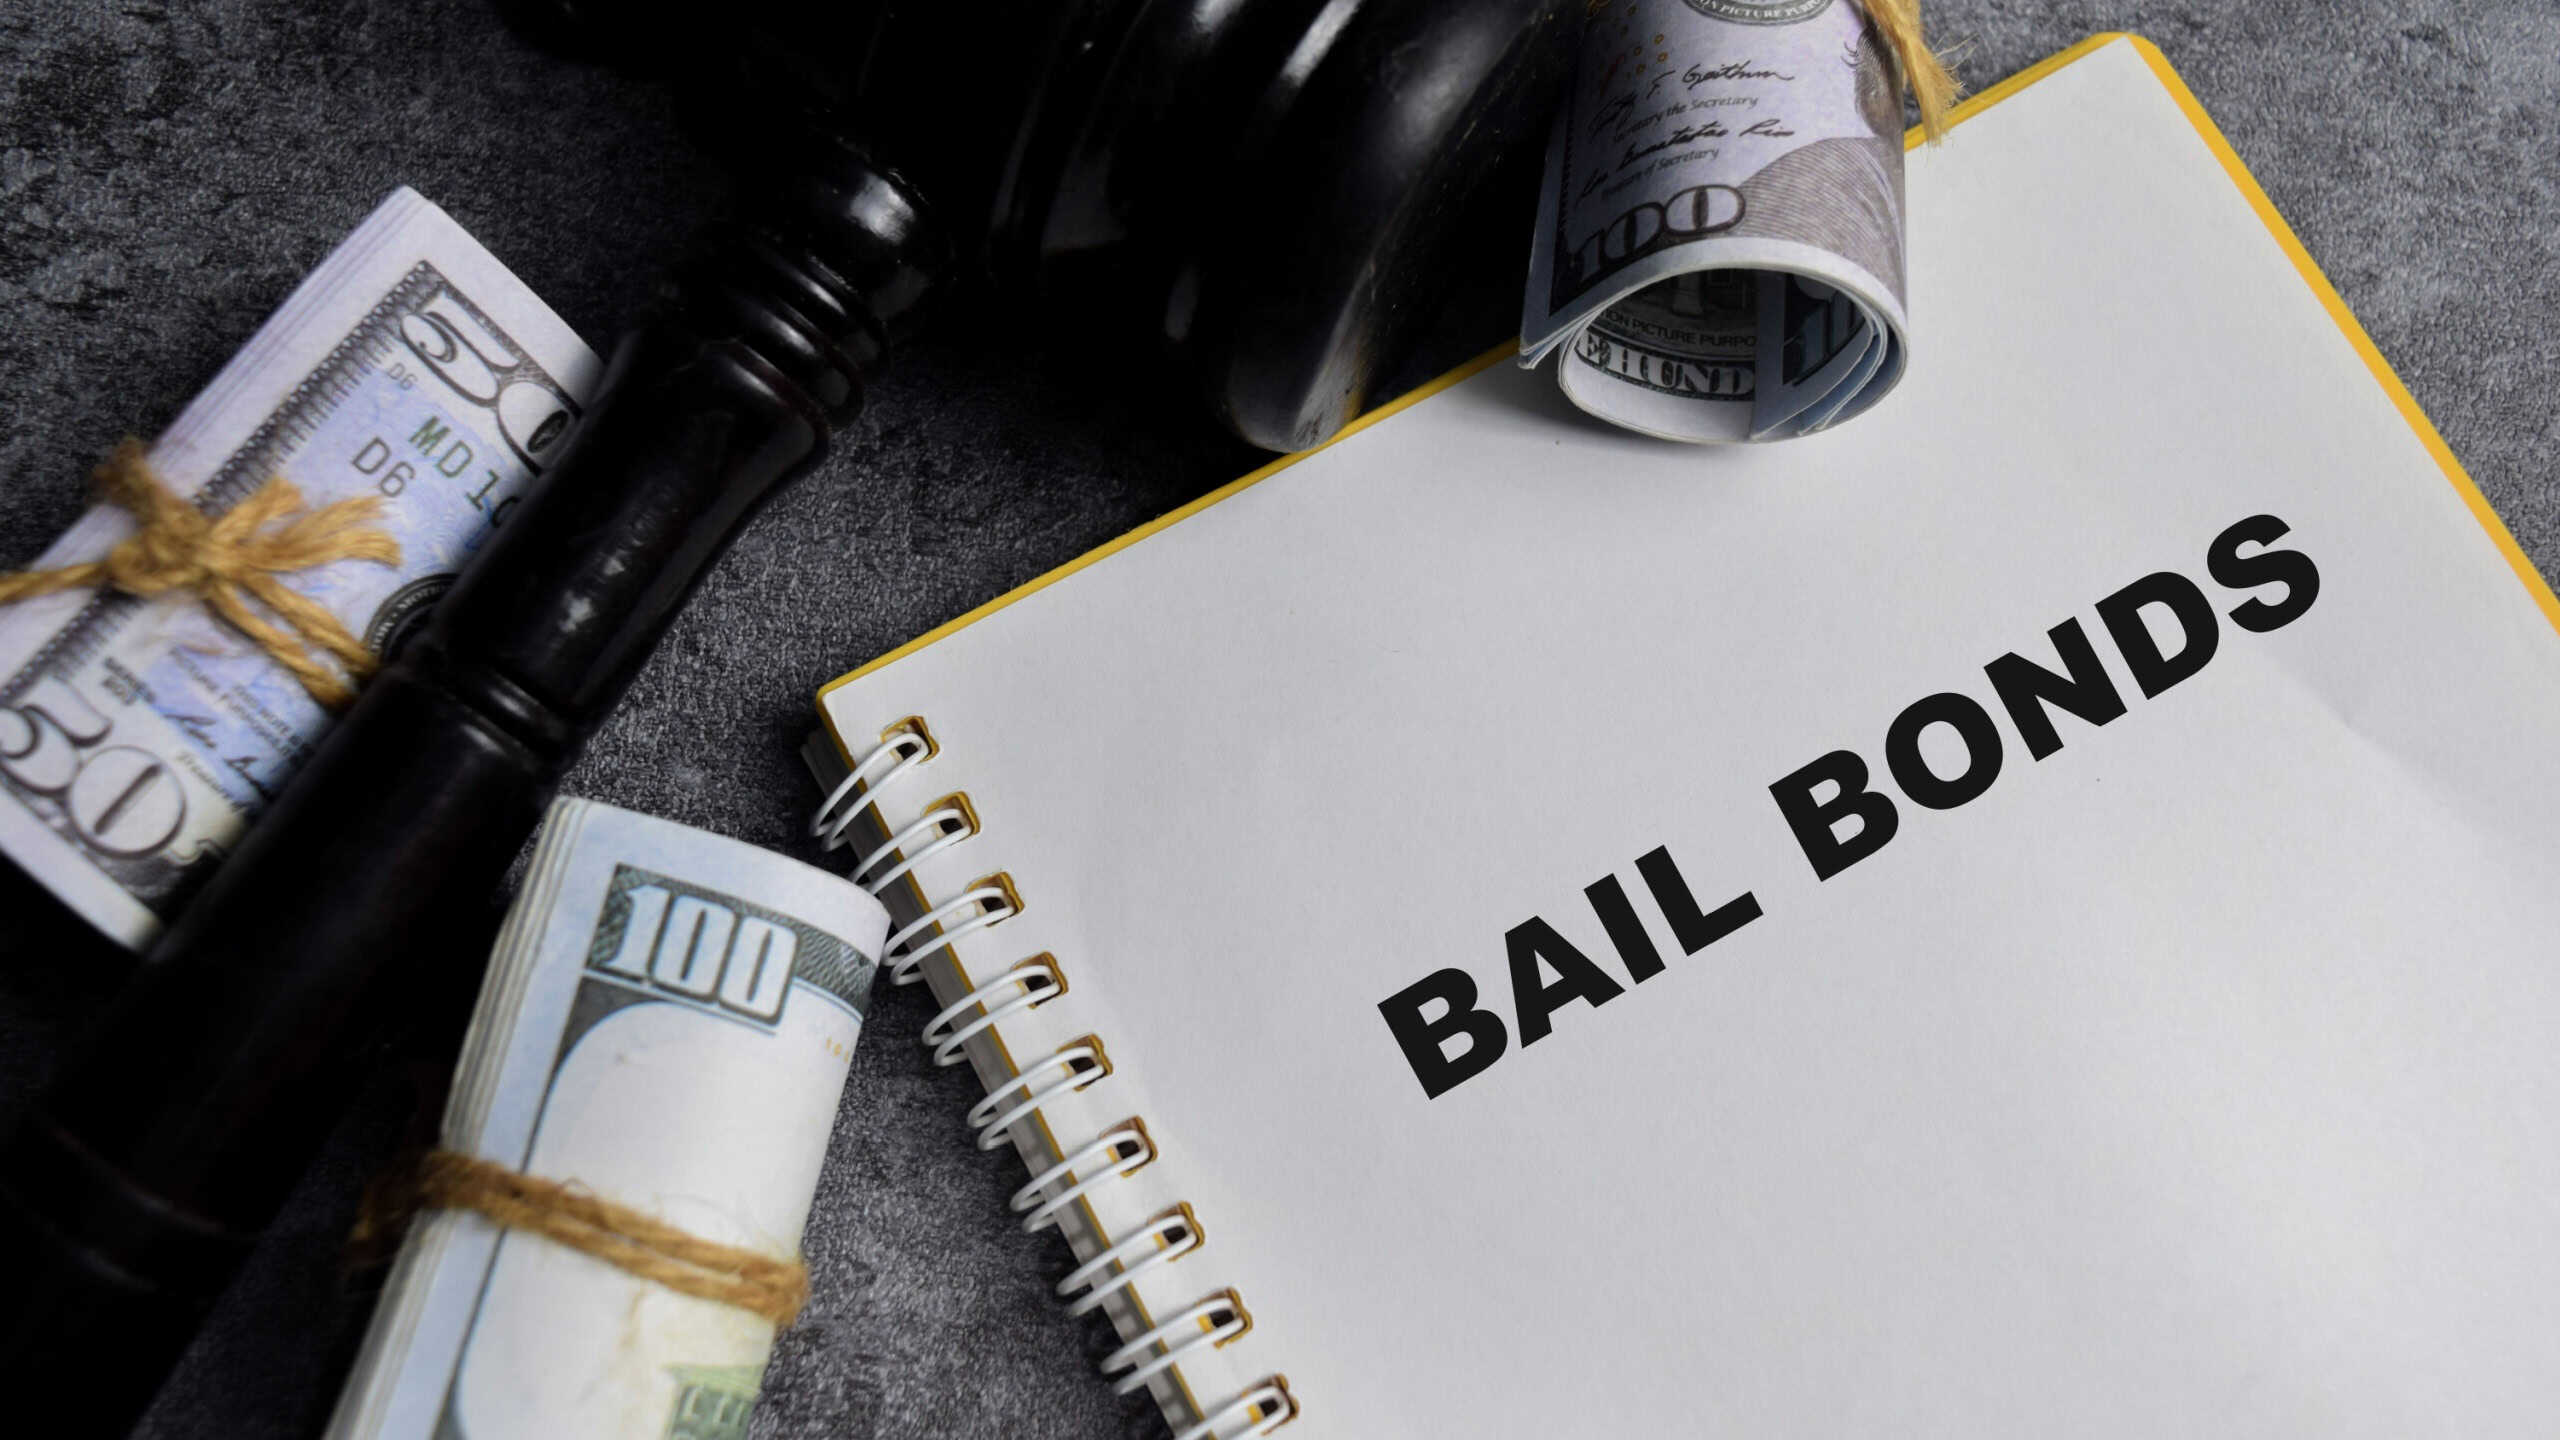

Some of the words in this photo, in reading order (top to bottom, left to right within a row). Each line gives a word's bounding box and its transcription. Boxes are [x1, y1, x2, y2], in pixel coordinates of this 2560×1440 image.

[1633, 319, 1697, 345] PICTURE
[388, 361, 418, 392] D6
[352, 436, 417, 498] D6
[1377, 845, 1764, 1100] BAIL
[1768, 514, 2321, 882] BONDS
[603, 884, 799, 1026] 100
